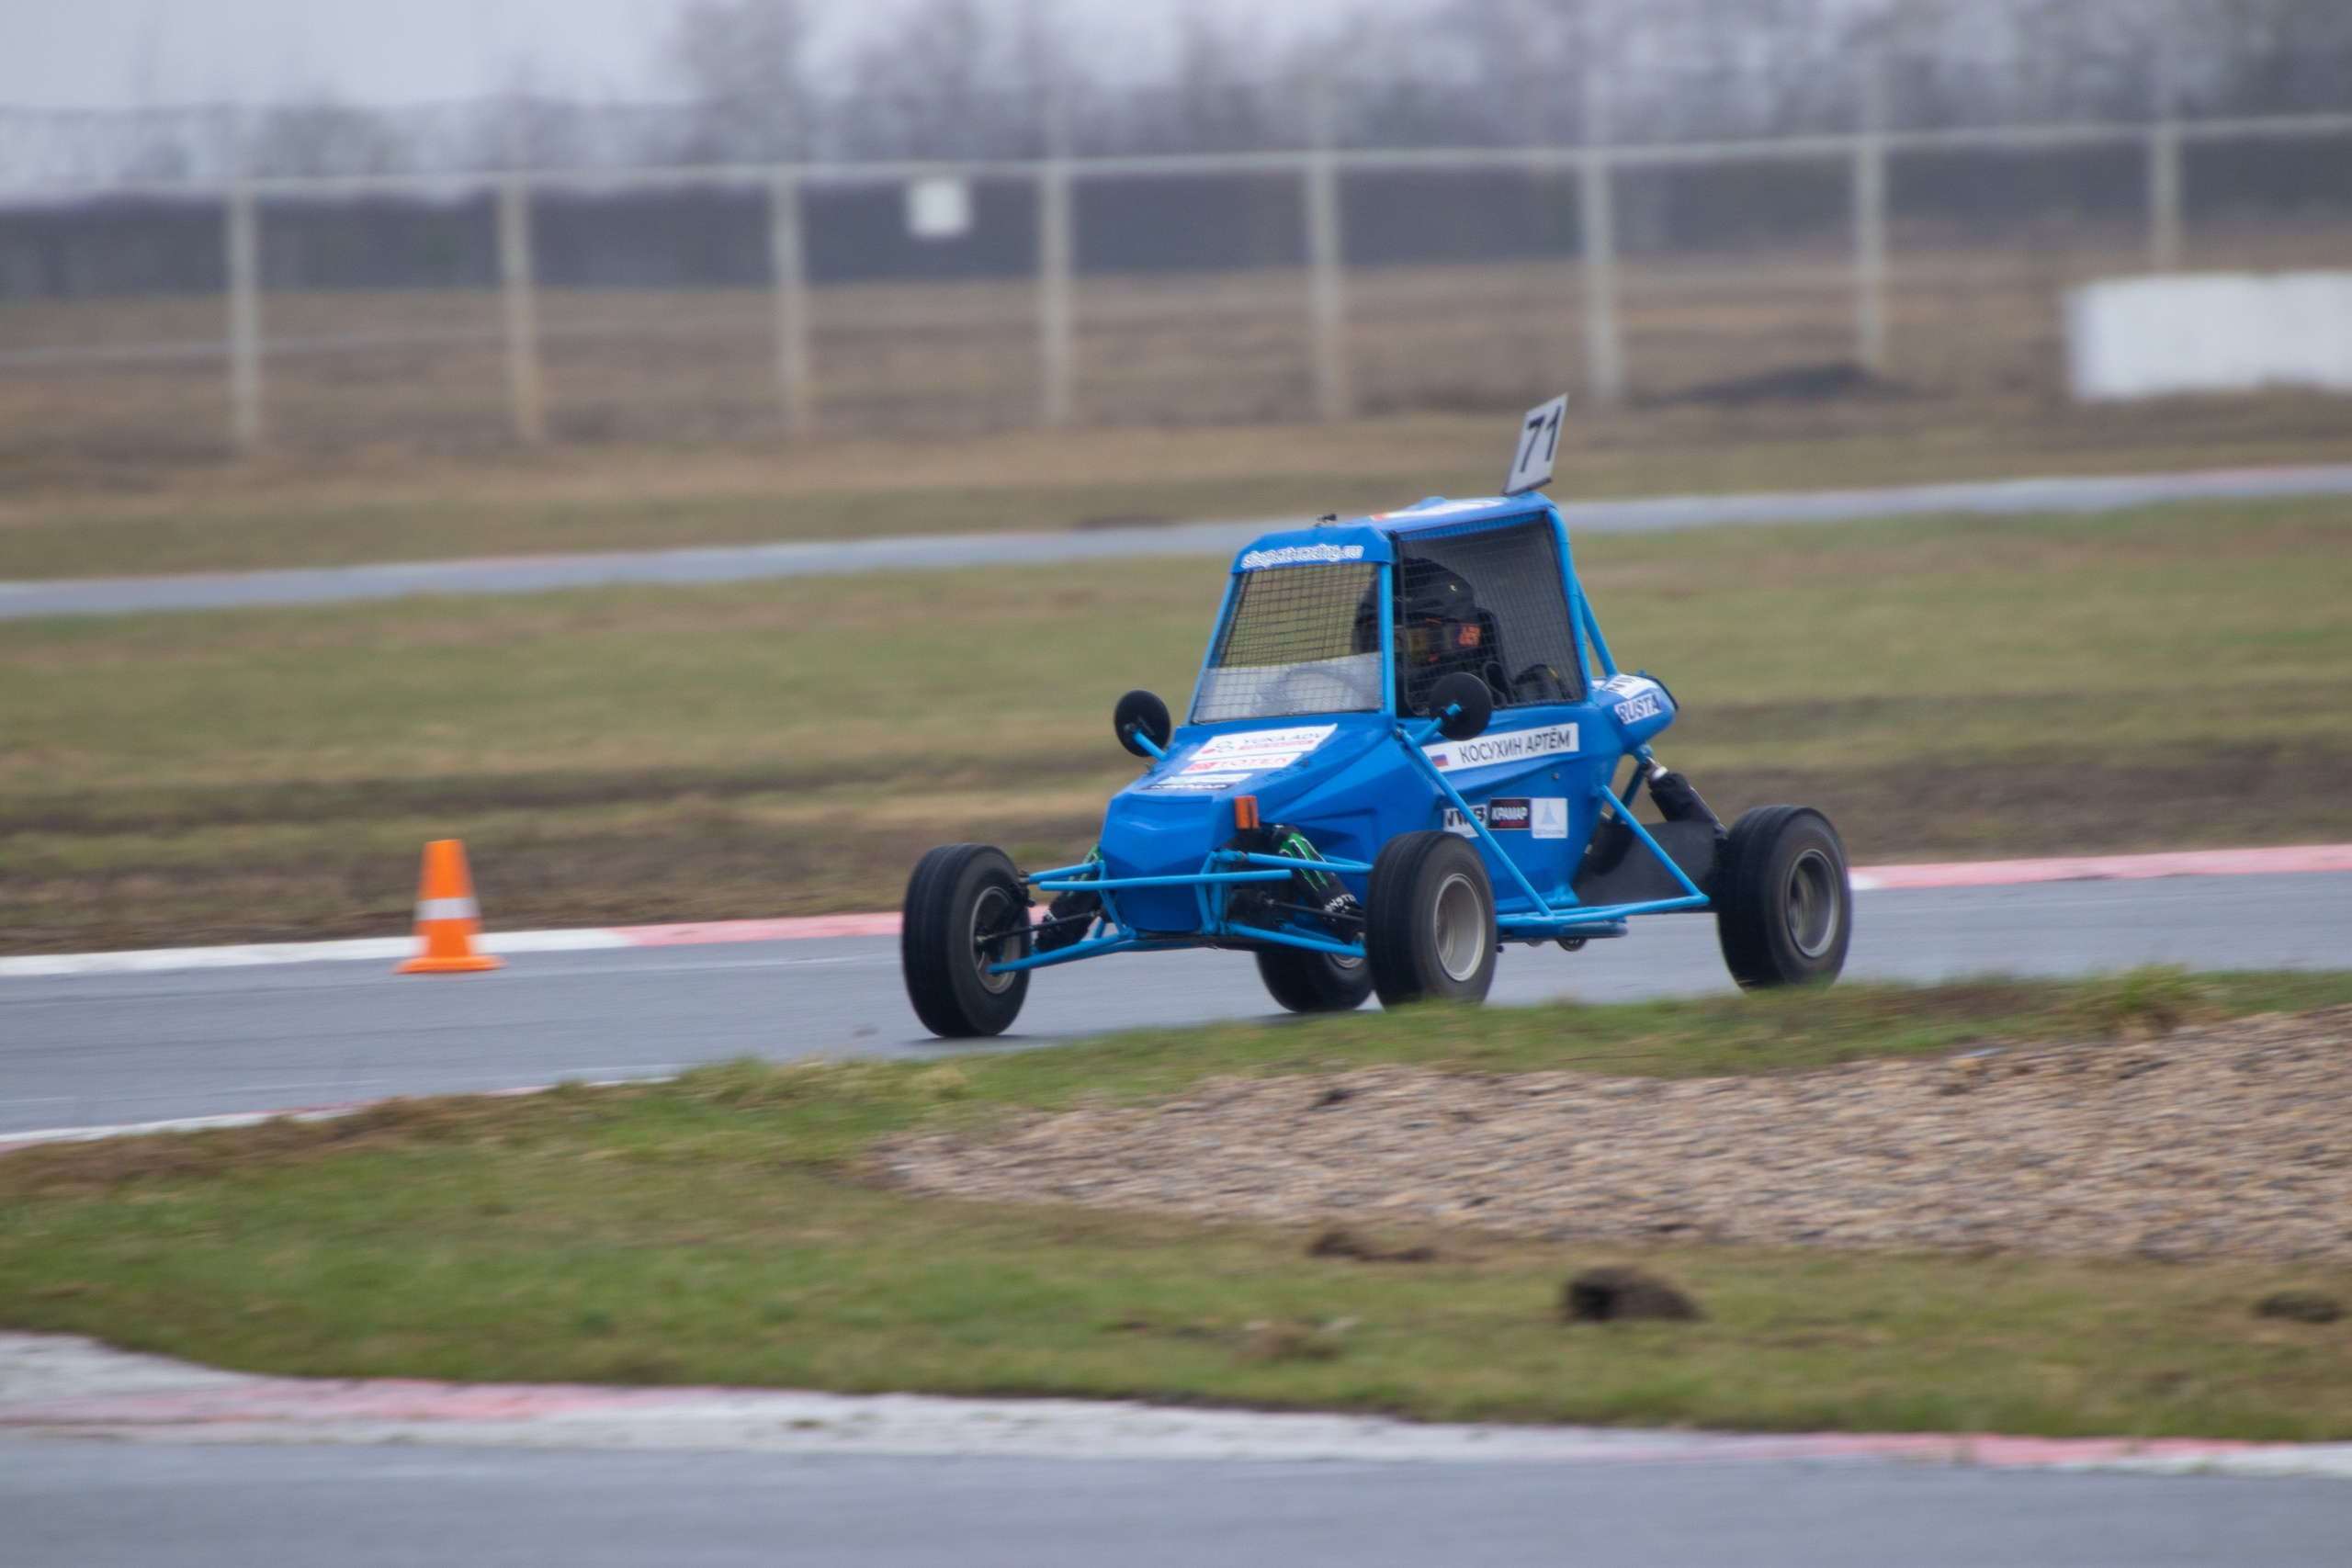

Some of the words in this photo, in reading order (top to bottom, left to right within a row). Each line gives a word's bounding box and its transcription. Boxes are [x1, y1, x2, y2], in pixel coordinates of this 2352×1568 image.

[1520, 404, 1562, 473] 71
[1618, 694, 1662, 723] RUSTA
[1458, 737, 1522, 764] КОСУХИН
[1525, 728, 1571, 752] АРТЁМ
